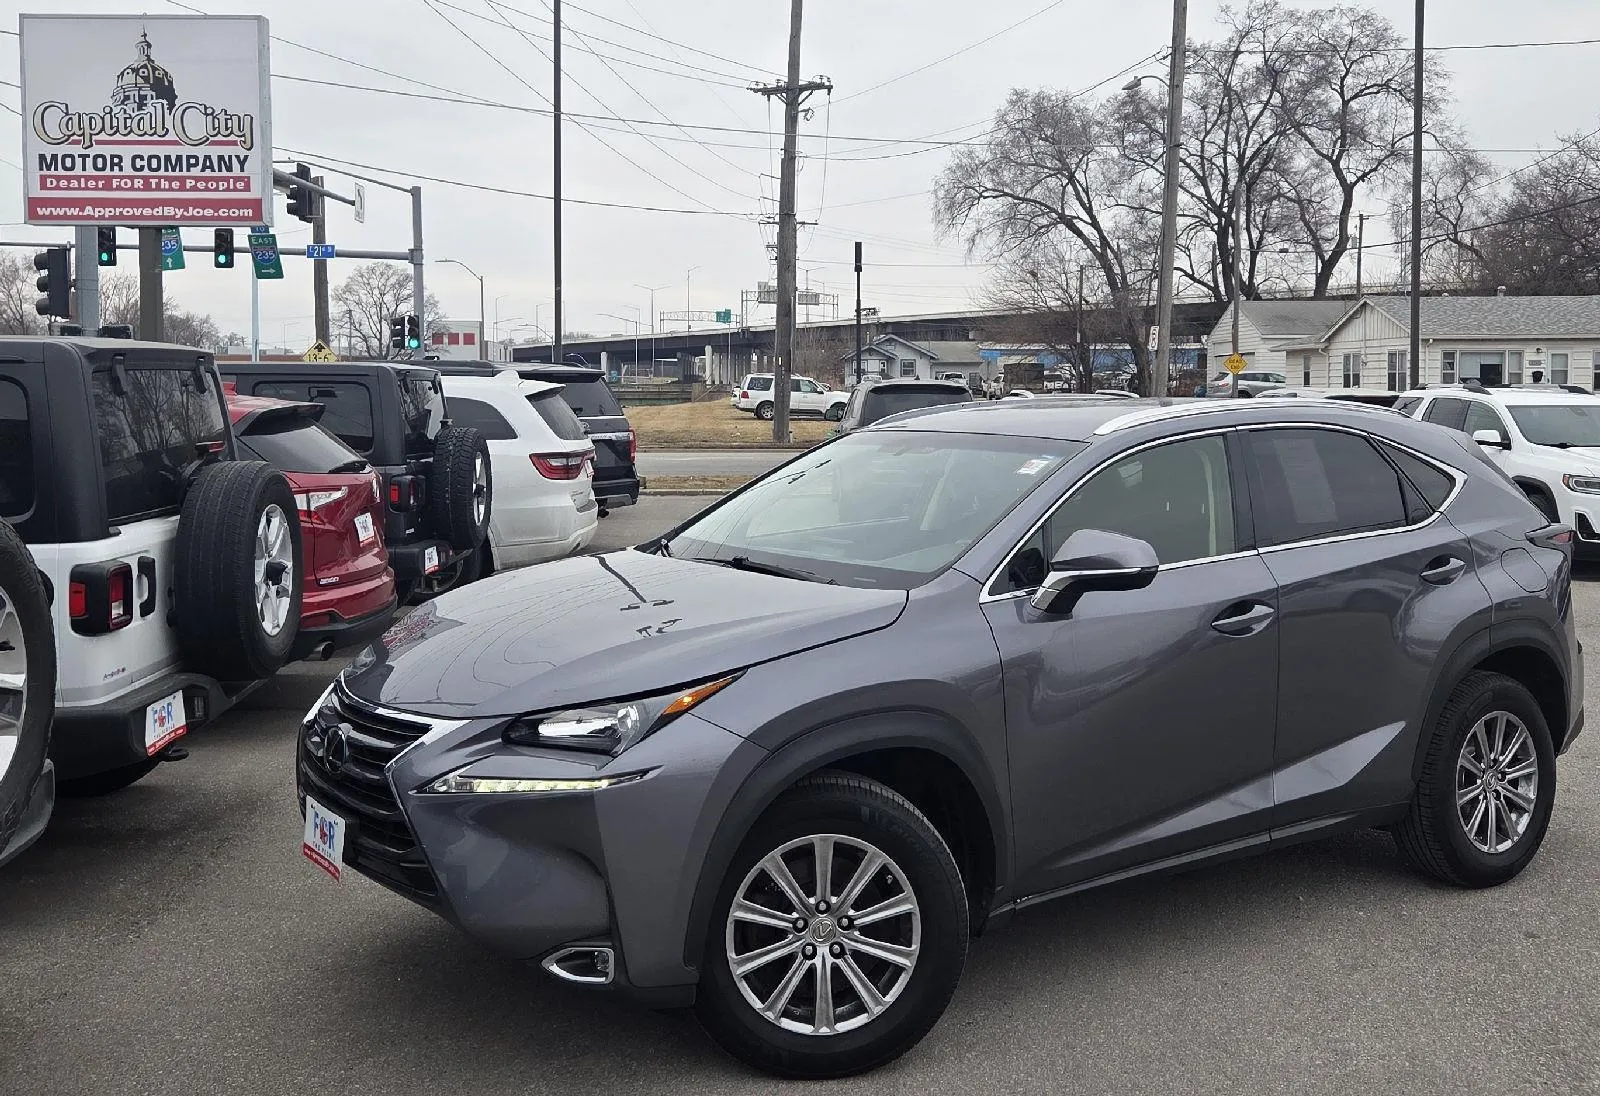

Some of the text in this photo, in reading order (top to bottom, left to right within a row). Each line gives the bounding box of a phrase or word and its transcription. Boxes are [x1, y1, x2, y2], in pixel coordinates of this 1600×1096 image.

[33, 100, 253, 150] Capital City
[38, 153, 249, 173] MOTOR COMPANY
[46, 178, 246, 190] Dealer FOR The People
[36, 205, 253, 219] www.ApprovedByJoe.com
[256, 250, 275, 260] 235
